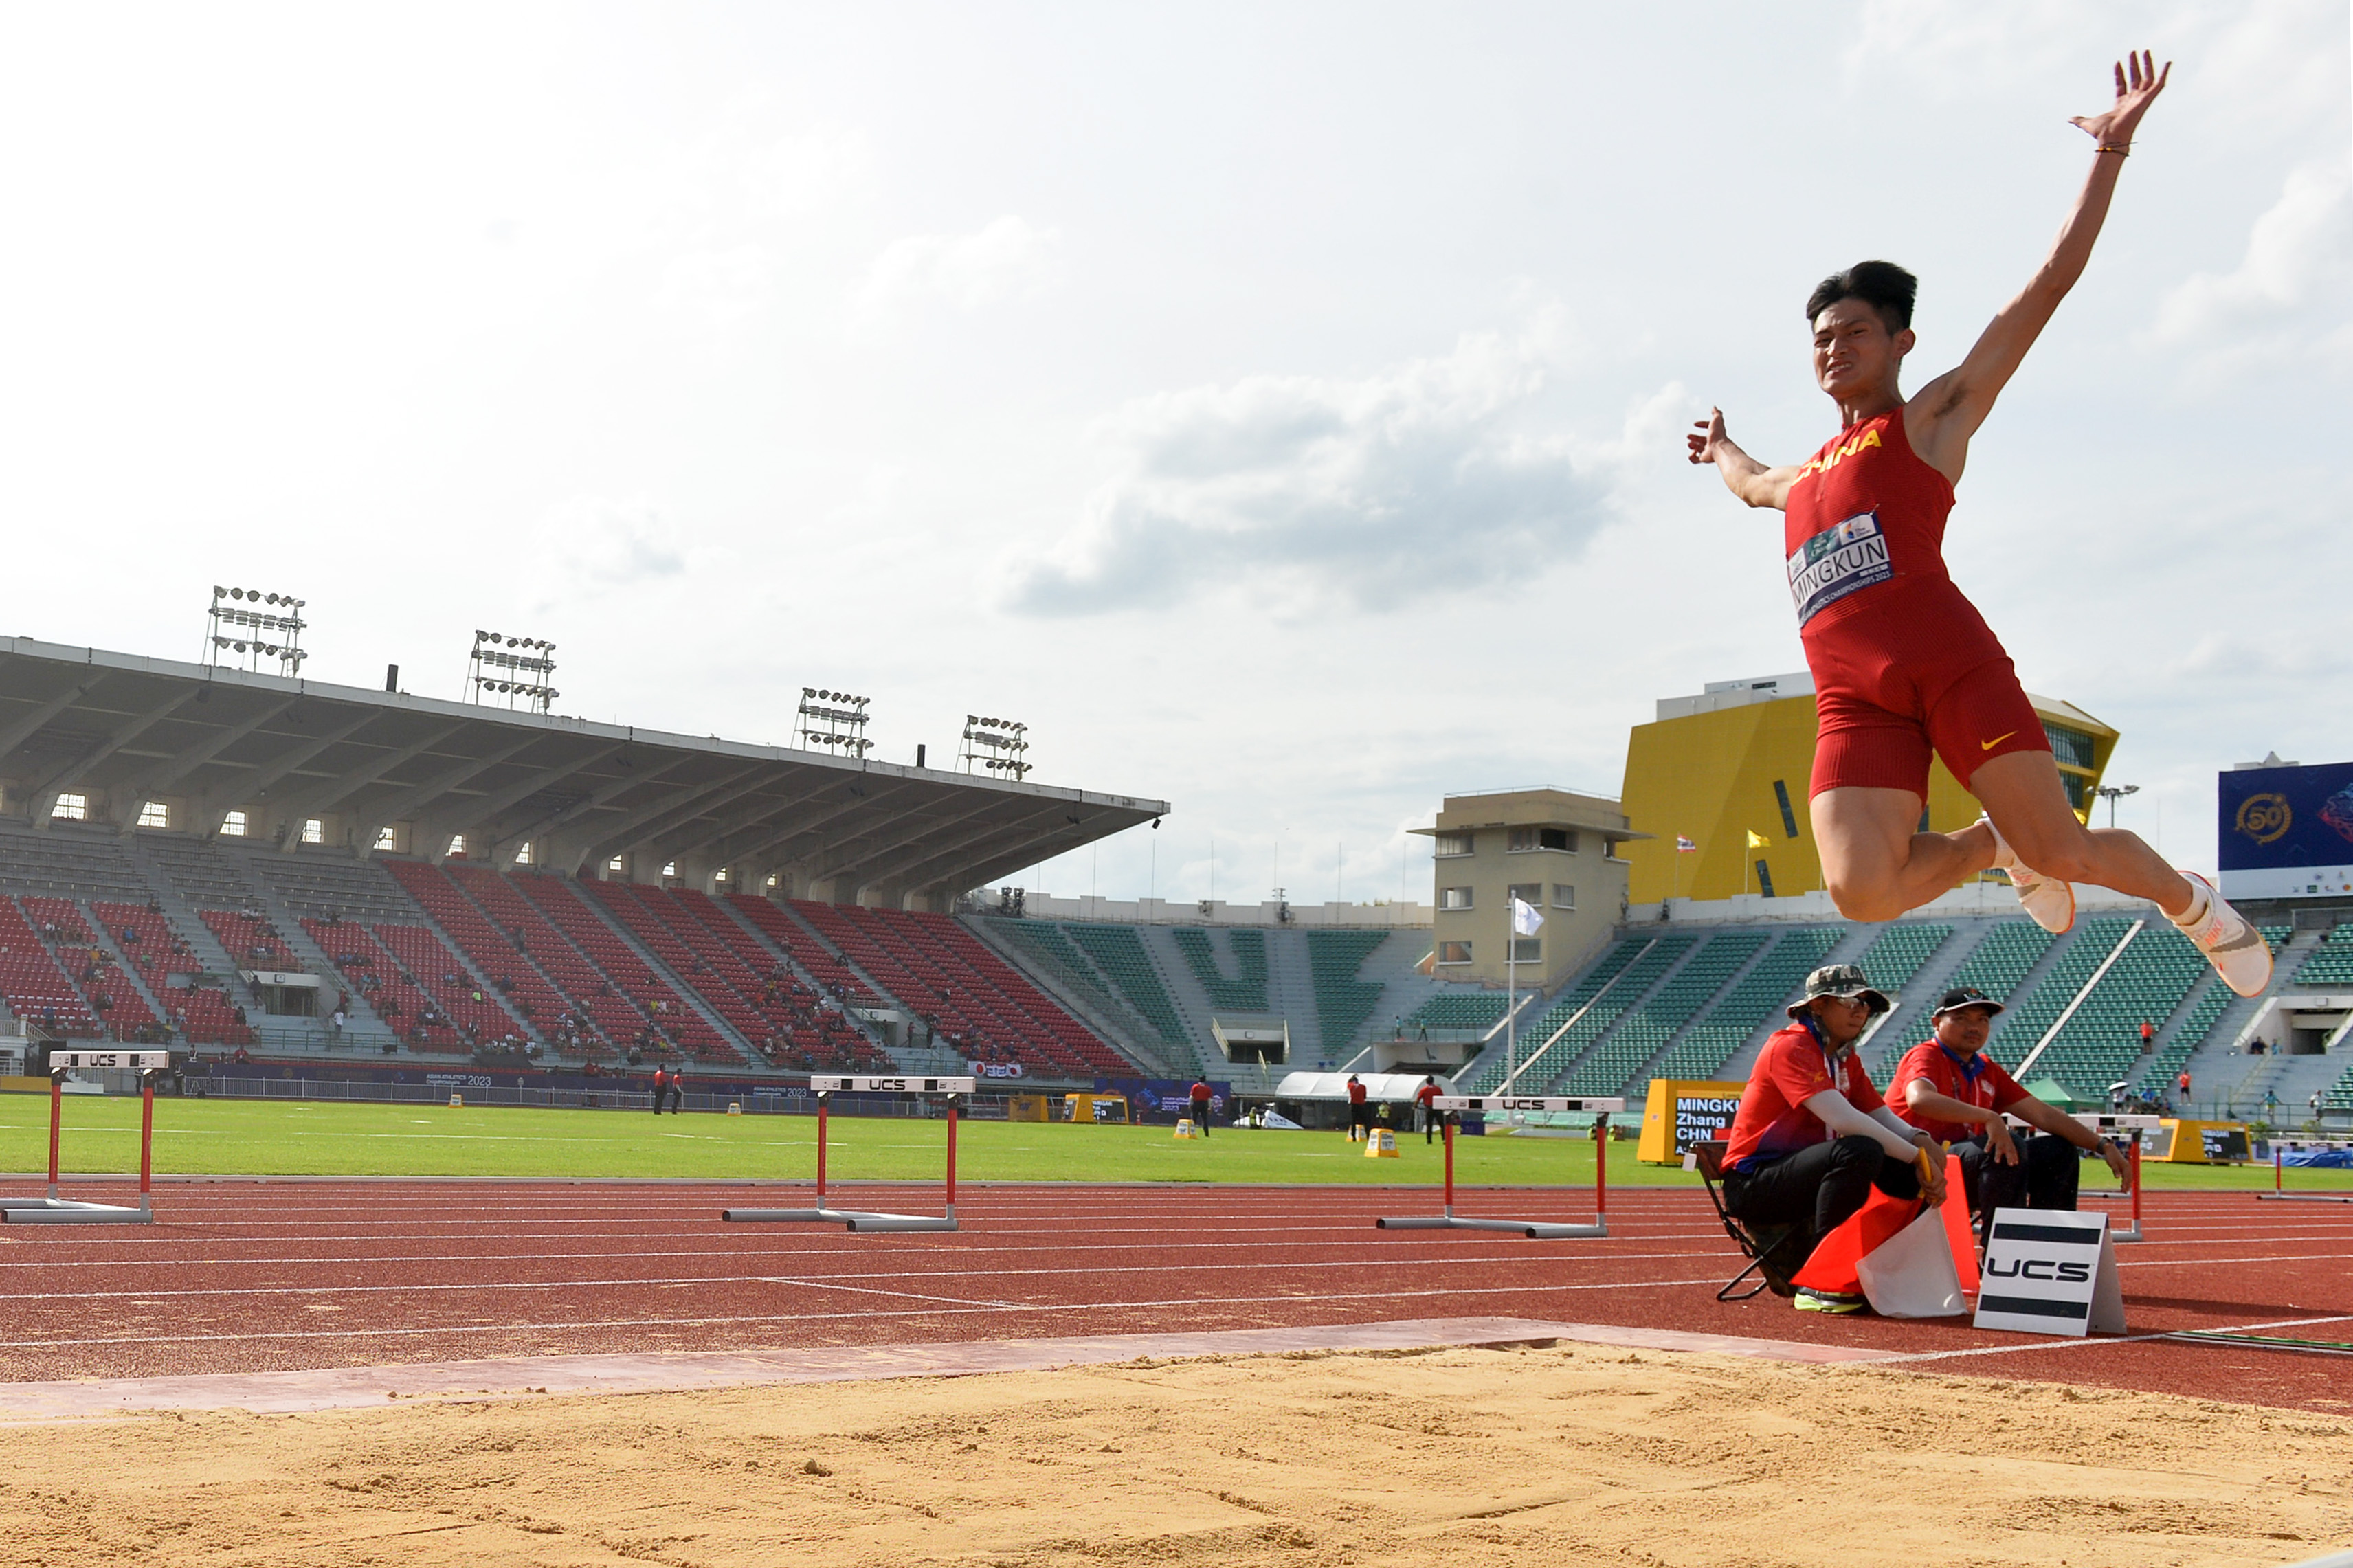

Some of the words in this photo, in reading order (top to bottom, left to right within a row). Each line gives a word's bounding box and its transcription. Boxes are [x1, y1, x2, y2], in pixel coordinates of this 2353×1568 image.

[1792, 429, 1882, 486] CHINA
[90, 1055, 116, 1066] UCS
[467, 1075, 491, 1086] 2023
[869, 1079, 906, 1090] UCS
[787, 1088, 807, 1097] 2023
[1502, 1099, 1545, 1110] UCS
[1676, 1112, 1726, 1128] Zhang
[1676, 1128, 1712, 1141] CHN
[1987, 1257, 2090, 1283] UCS
